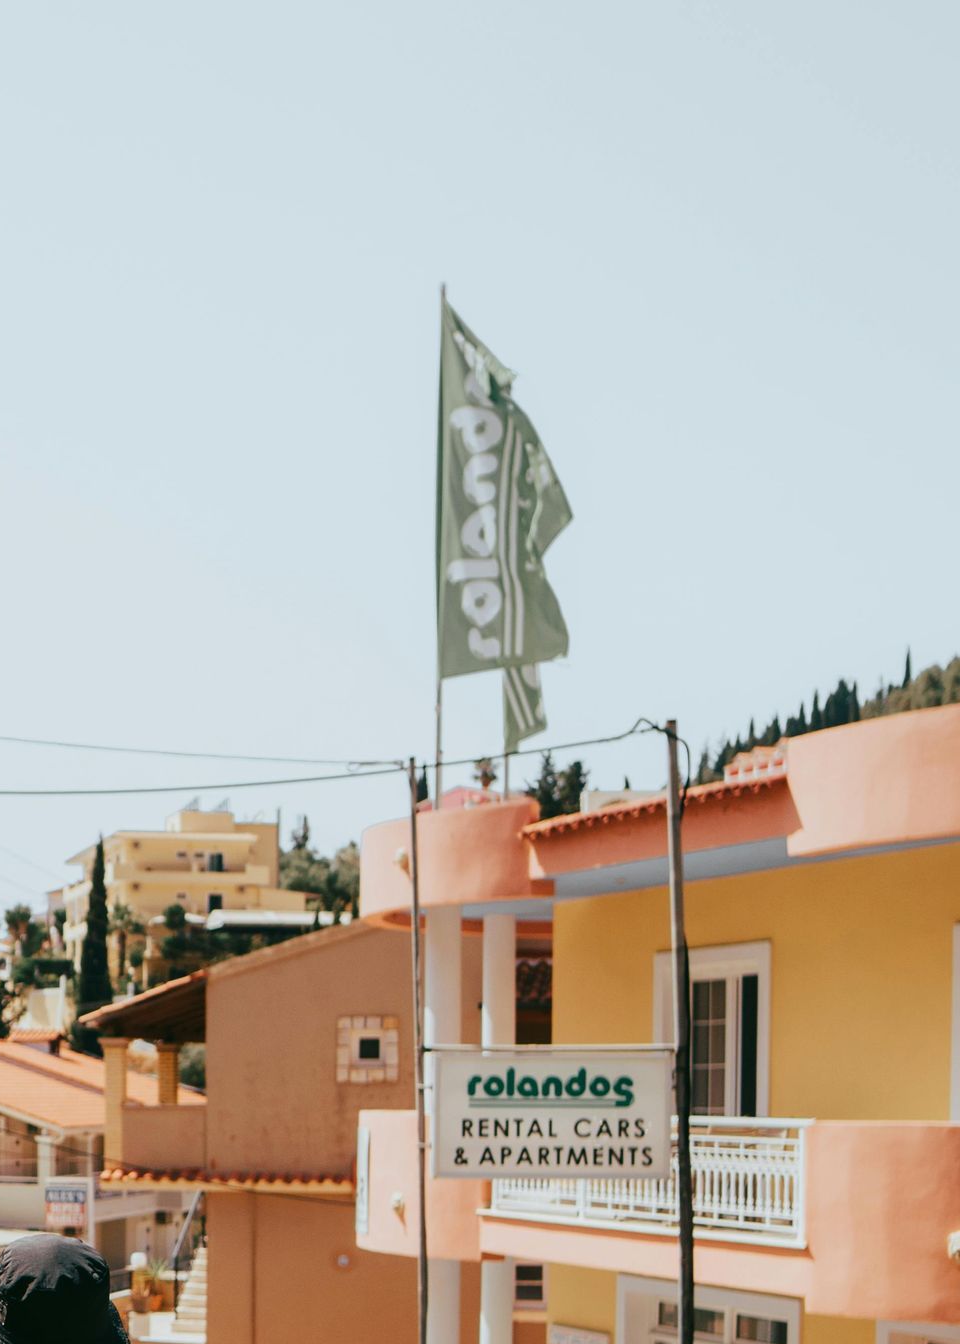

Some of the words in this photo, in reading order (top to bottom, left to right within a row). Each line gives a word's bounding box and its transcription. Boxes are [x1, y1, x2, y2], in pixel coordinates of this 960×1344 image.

[467, 1067, 635, 1108] rolandos
[461, 1118, 557, 1138] RENTAL
[574, 1118, 646, 1138] CARS
[454, 1147, 469, 1166] &
[480, 1146, 653, 1167] APARTMENTS
